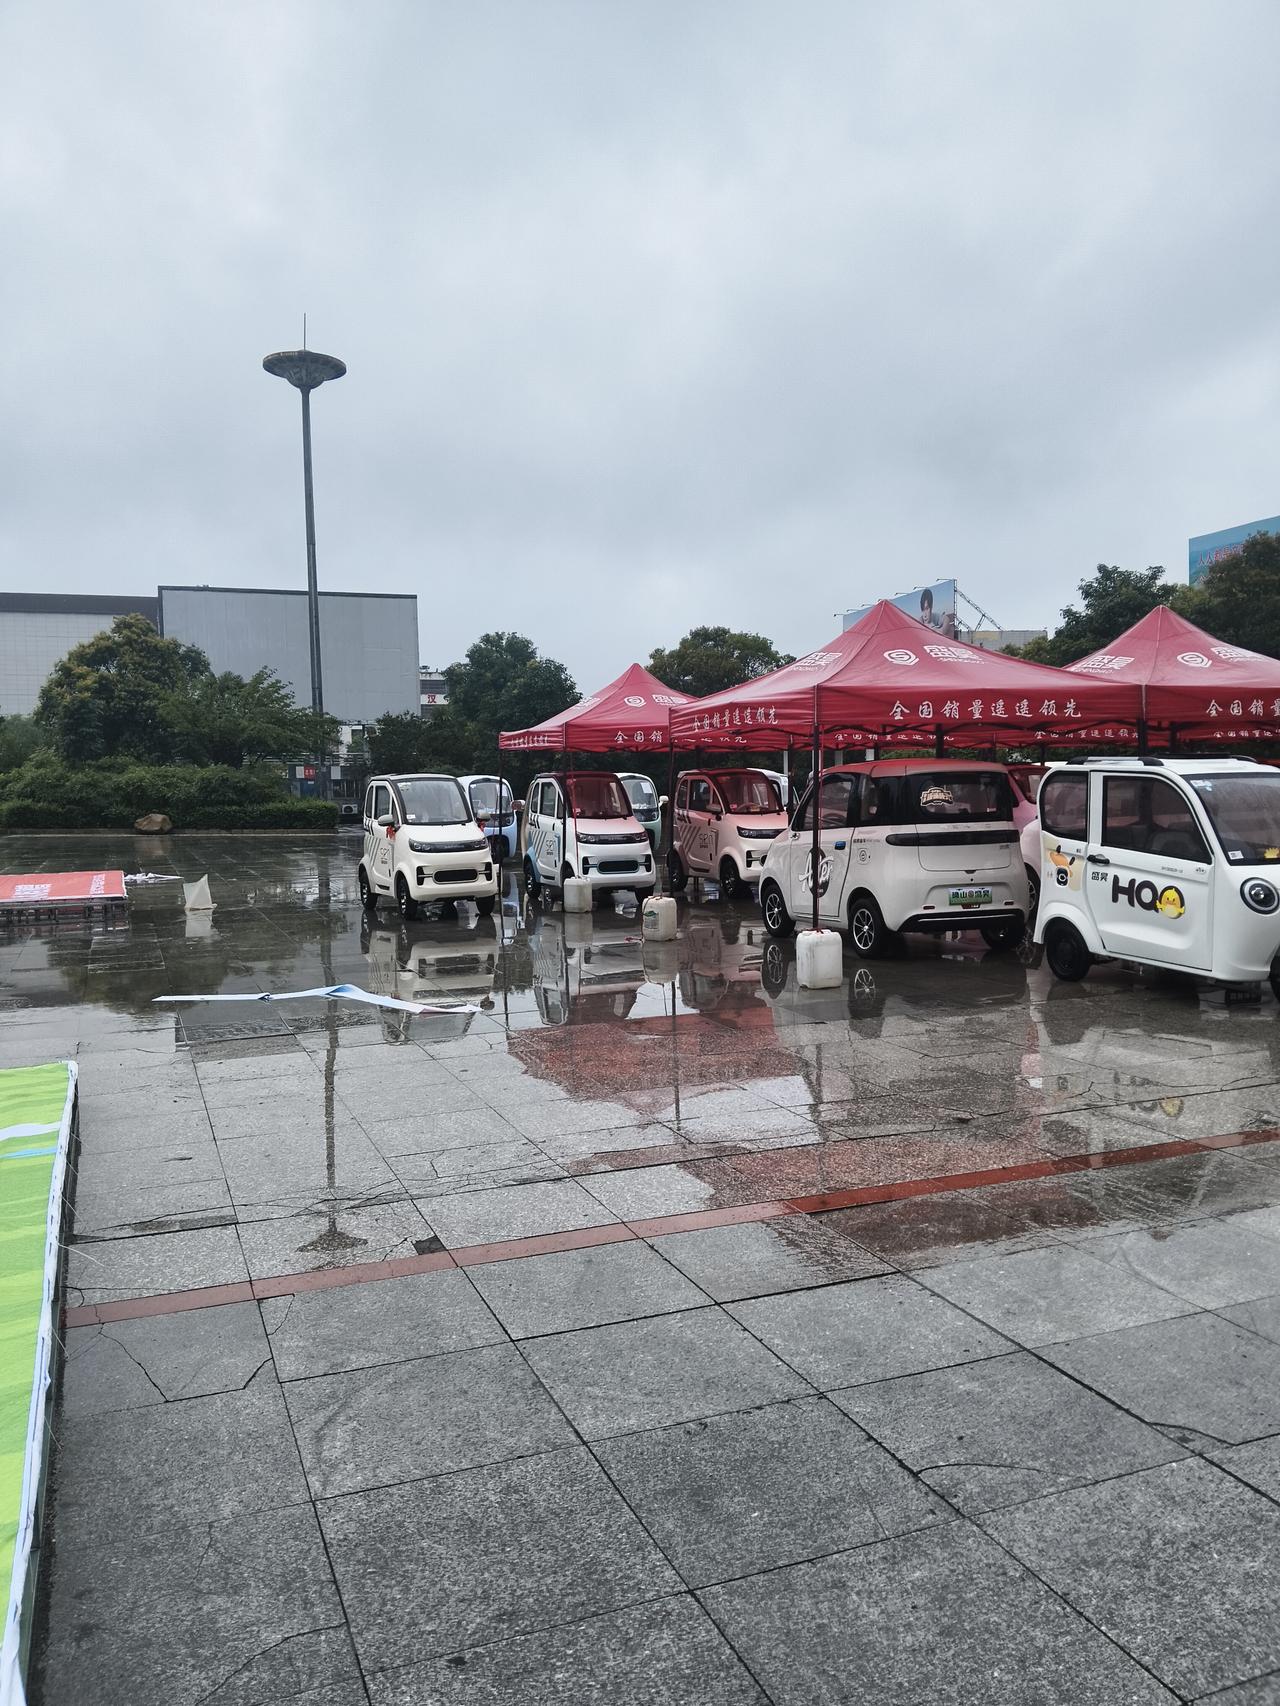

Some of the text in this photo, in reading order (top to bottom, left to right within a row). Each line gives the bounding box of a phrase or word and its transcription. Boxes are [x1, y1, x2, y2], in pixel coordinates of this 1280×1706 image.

[692, 705, 778, 733] 全国销量遥遥领先
[889, 698, 1082, 720] 全国销量遥遥领先
